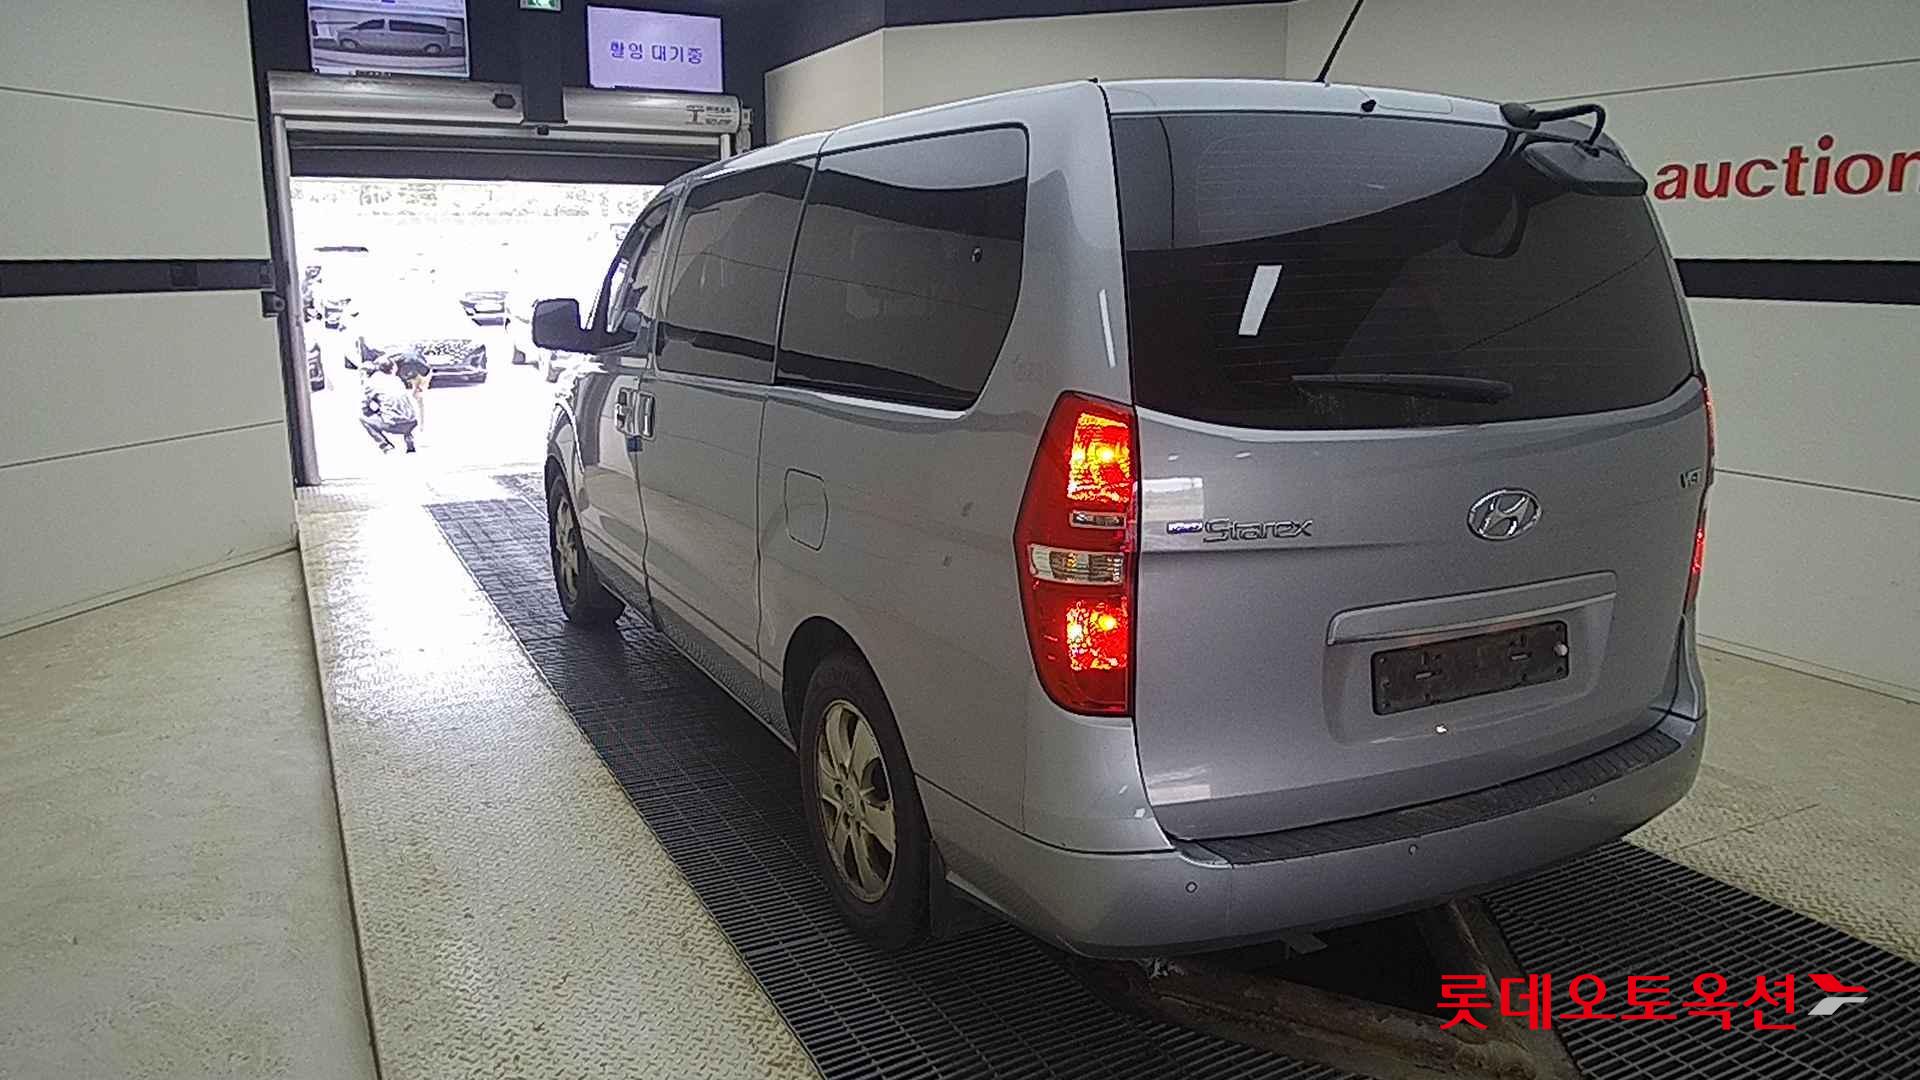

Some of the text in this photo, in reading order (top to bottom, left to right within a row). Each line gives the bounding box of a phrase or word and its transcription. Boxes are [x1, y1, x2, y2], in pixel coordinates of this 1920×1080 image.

[651, 44, 703, 65] 대기중
[1654, 134, 1920, 200] auction
[1203, 518, 1313, 543] Starex
